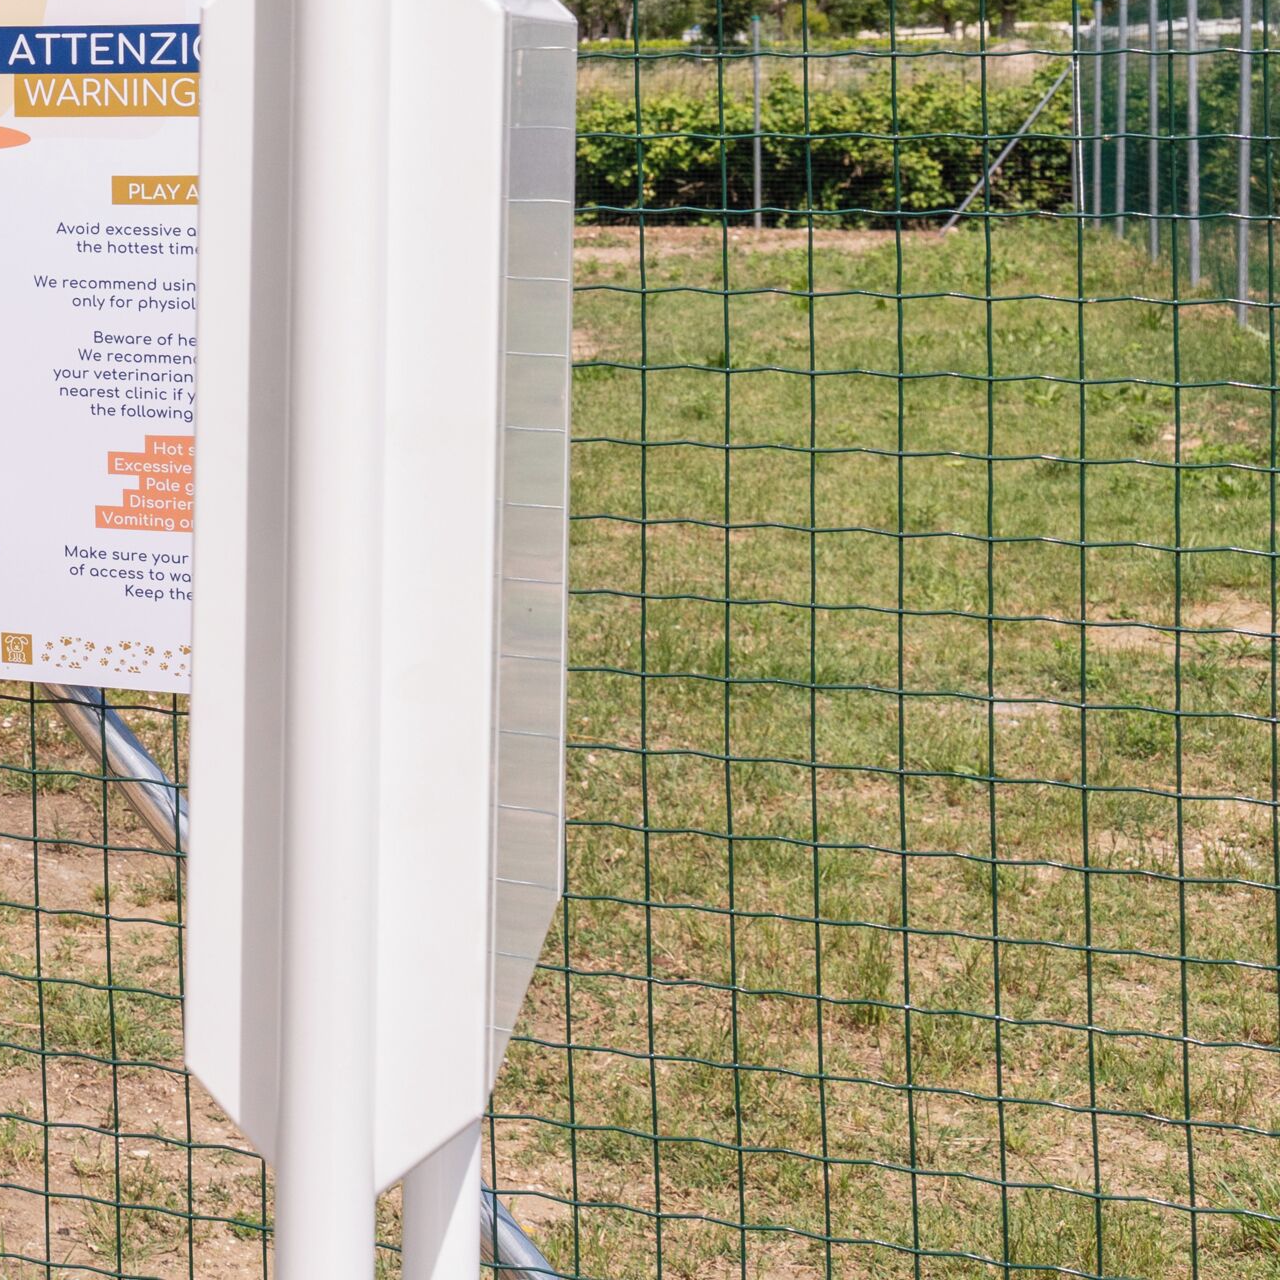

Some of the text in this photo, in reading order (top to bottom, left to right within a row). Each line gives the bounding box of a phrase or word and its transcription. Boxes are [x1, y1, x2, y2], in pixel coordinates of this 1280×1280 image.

[8, 32, 200, 66] ATTENZI
[129, 183, 180, 200] PLAY
[56, 222, 100, 235] Avoid
[105, 224, 182, 237] excessive
[76, 240, 102, 253] the
[107, 241, 164, 254] hottest
[34, 275, 196, 292] We recommend usin
[72, 294, 196, 312] only for physiol
[94, 330, 197, 347] Beware of he
[78, 348, 197, 365] We recommen
[53, 368, 193, 383] your veterinarian
[60, 387, 120, 398] nearest
[125, 386, 167, 400] clinic
[173, 388, 183, 400] if
[90, 403, 193, 423] the following
[153, 442, 183, 456] Hot
[114, 457, 193, 474] Excessive
[146, 477, 180, 492] Pale
[102, 511, 175, 530] Vomiting
[65, 545, 189, 566] Make sure your
[69, 563, 85, 576] of
[90, 568, 144, 580] access
[149, 569, 165, 581] to
[125, 584, 192, 602] Keep the
